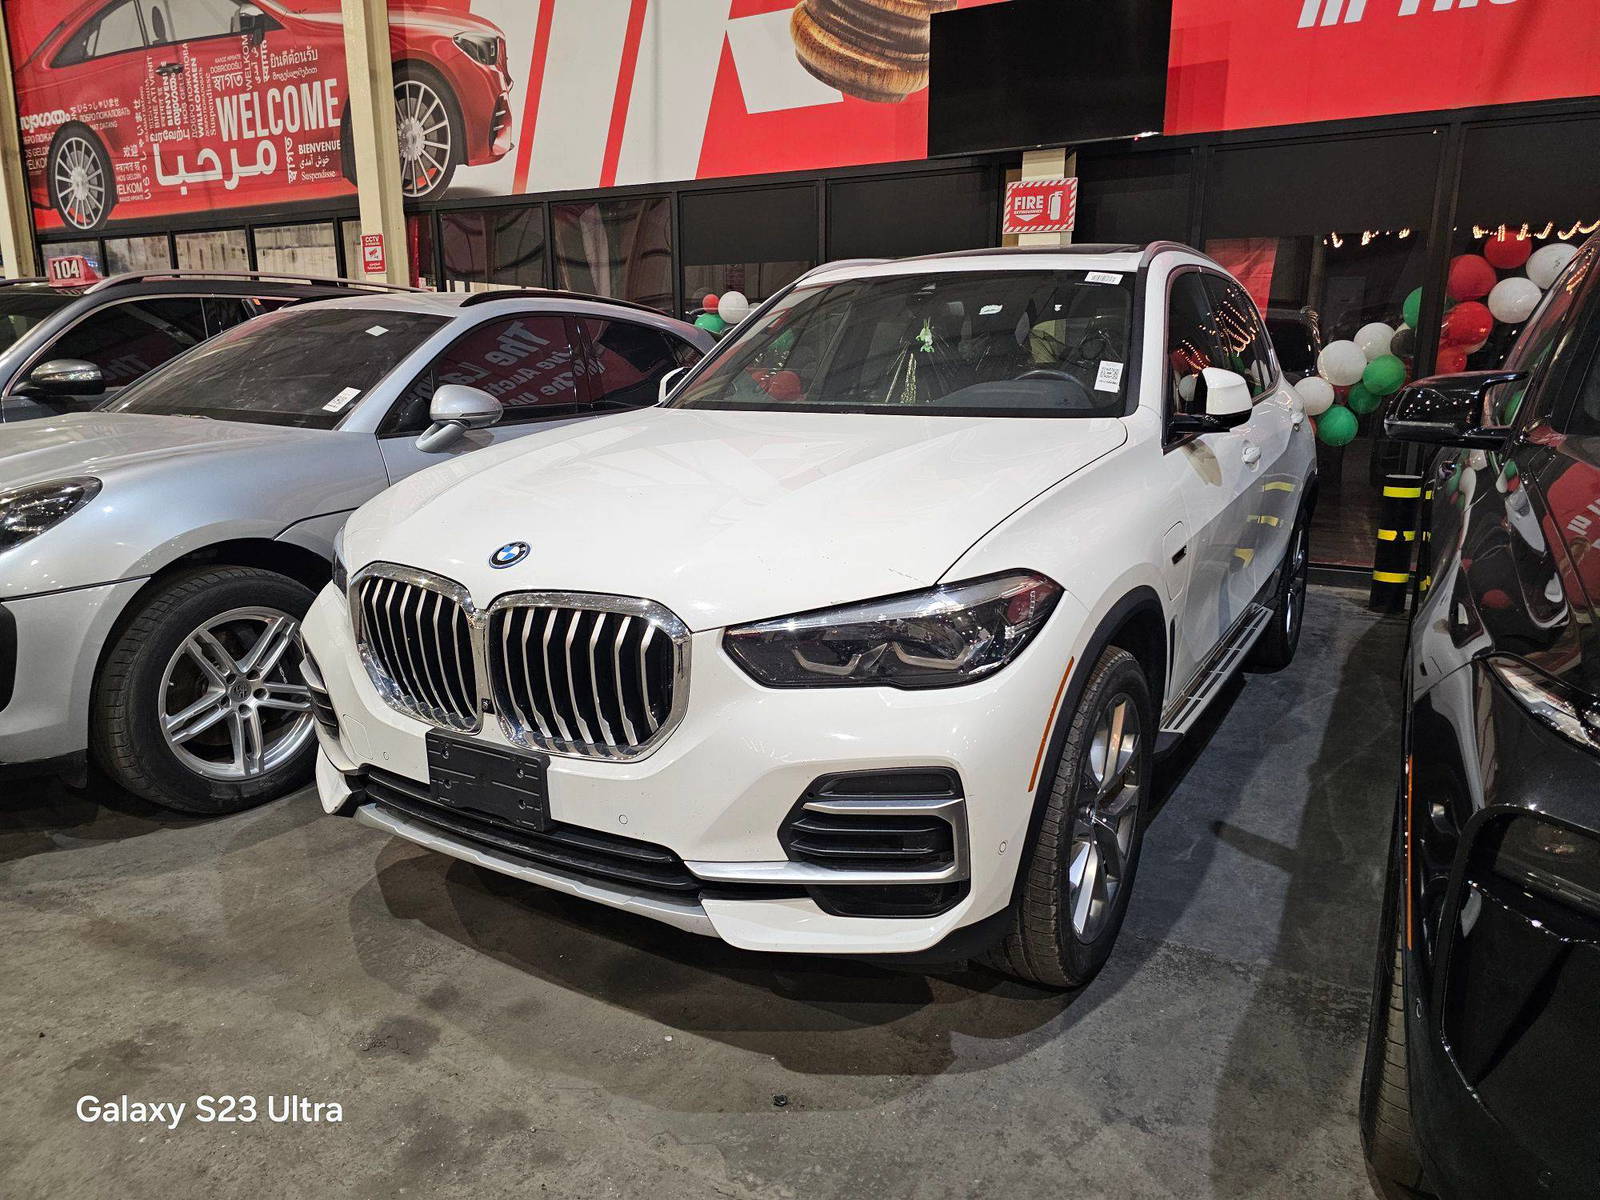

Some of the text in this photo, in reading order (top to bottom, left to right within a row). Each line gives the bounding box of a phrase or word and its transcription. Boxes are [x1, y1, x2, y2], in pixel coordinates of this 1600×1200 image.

[160, 61, 174, 127] BIENVENE
[190, 58, 204, 138] WILLKOMMEN
[215, 78, 341, 142] WELCOME
[152, 139, 278, 196] مرحبا
[298, 139, 341, 154] BIENVENUE
[1014, 195, 1044, 210] FIRE
[53, 259, 80, 279] 104
